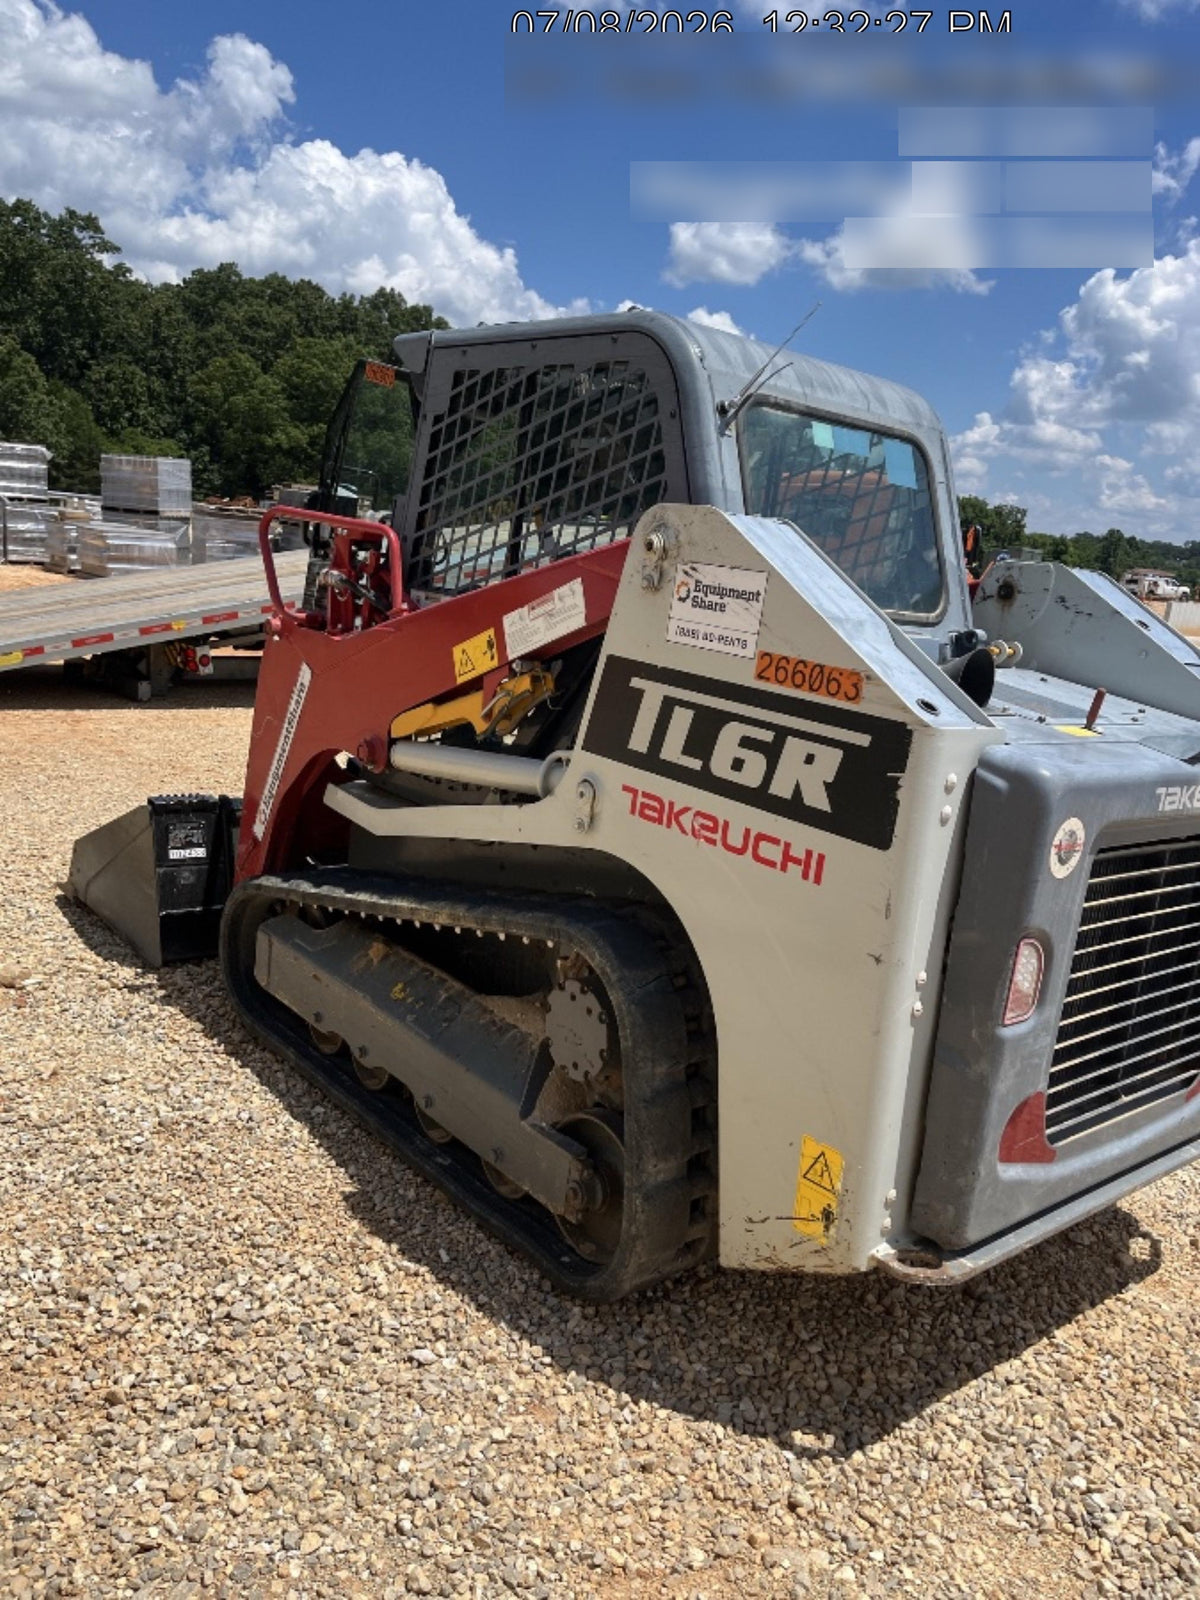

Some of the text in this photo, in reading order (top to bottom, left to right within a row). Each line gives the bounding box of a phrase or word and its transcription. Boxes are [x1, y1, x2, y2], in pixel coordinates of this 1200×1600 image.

[690, 596, 727, 613] Share
[693, 579, 762, 603] Equipment
[757, 651, 861, 701] 266063
[627, 676, 872, 813] TL6R
[621, 783, 826, 886] TAKEUCHI
